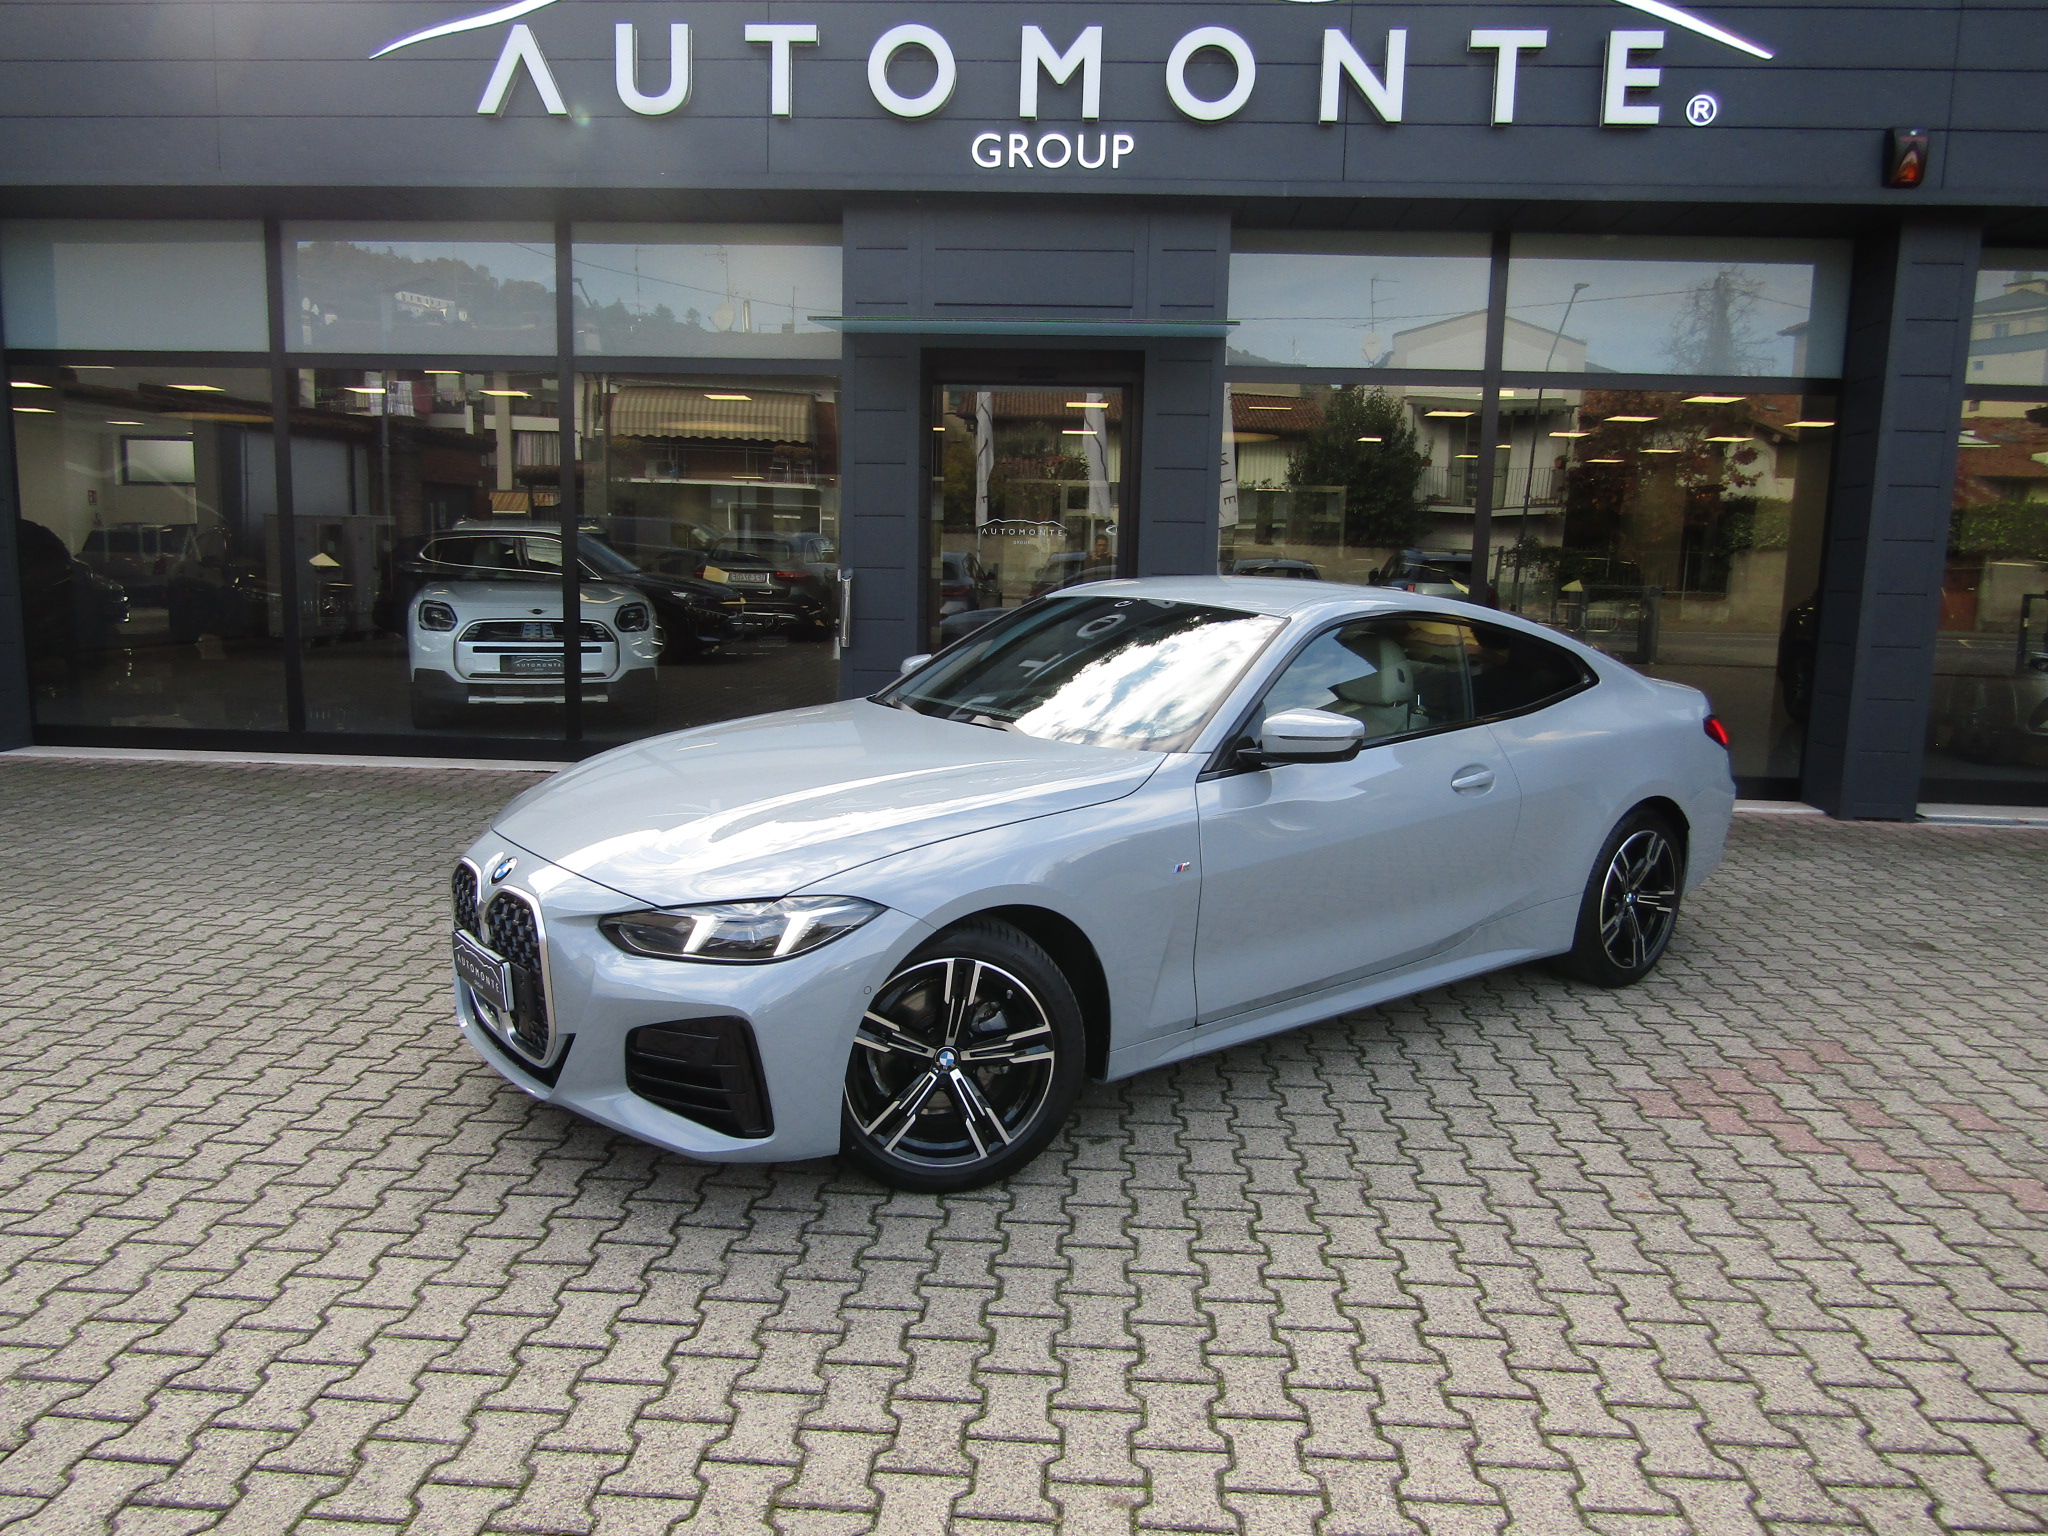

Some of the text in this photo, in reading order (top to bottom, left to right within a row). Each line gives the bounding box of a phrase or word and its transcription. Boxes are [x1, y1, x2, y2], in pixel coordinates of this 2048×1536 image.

[477, 22, 1665, 128] AUTOMONTE
[970, 132, 1136, 171] GROUP
[981, 527, 1062, 537] AUTOMONTE
[456, 952, 500, 993] AUTOMONTE
